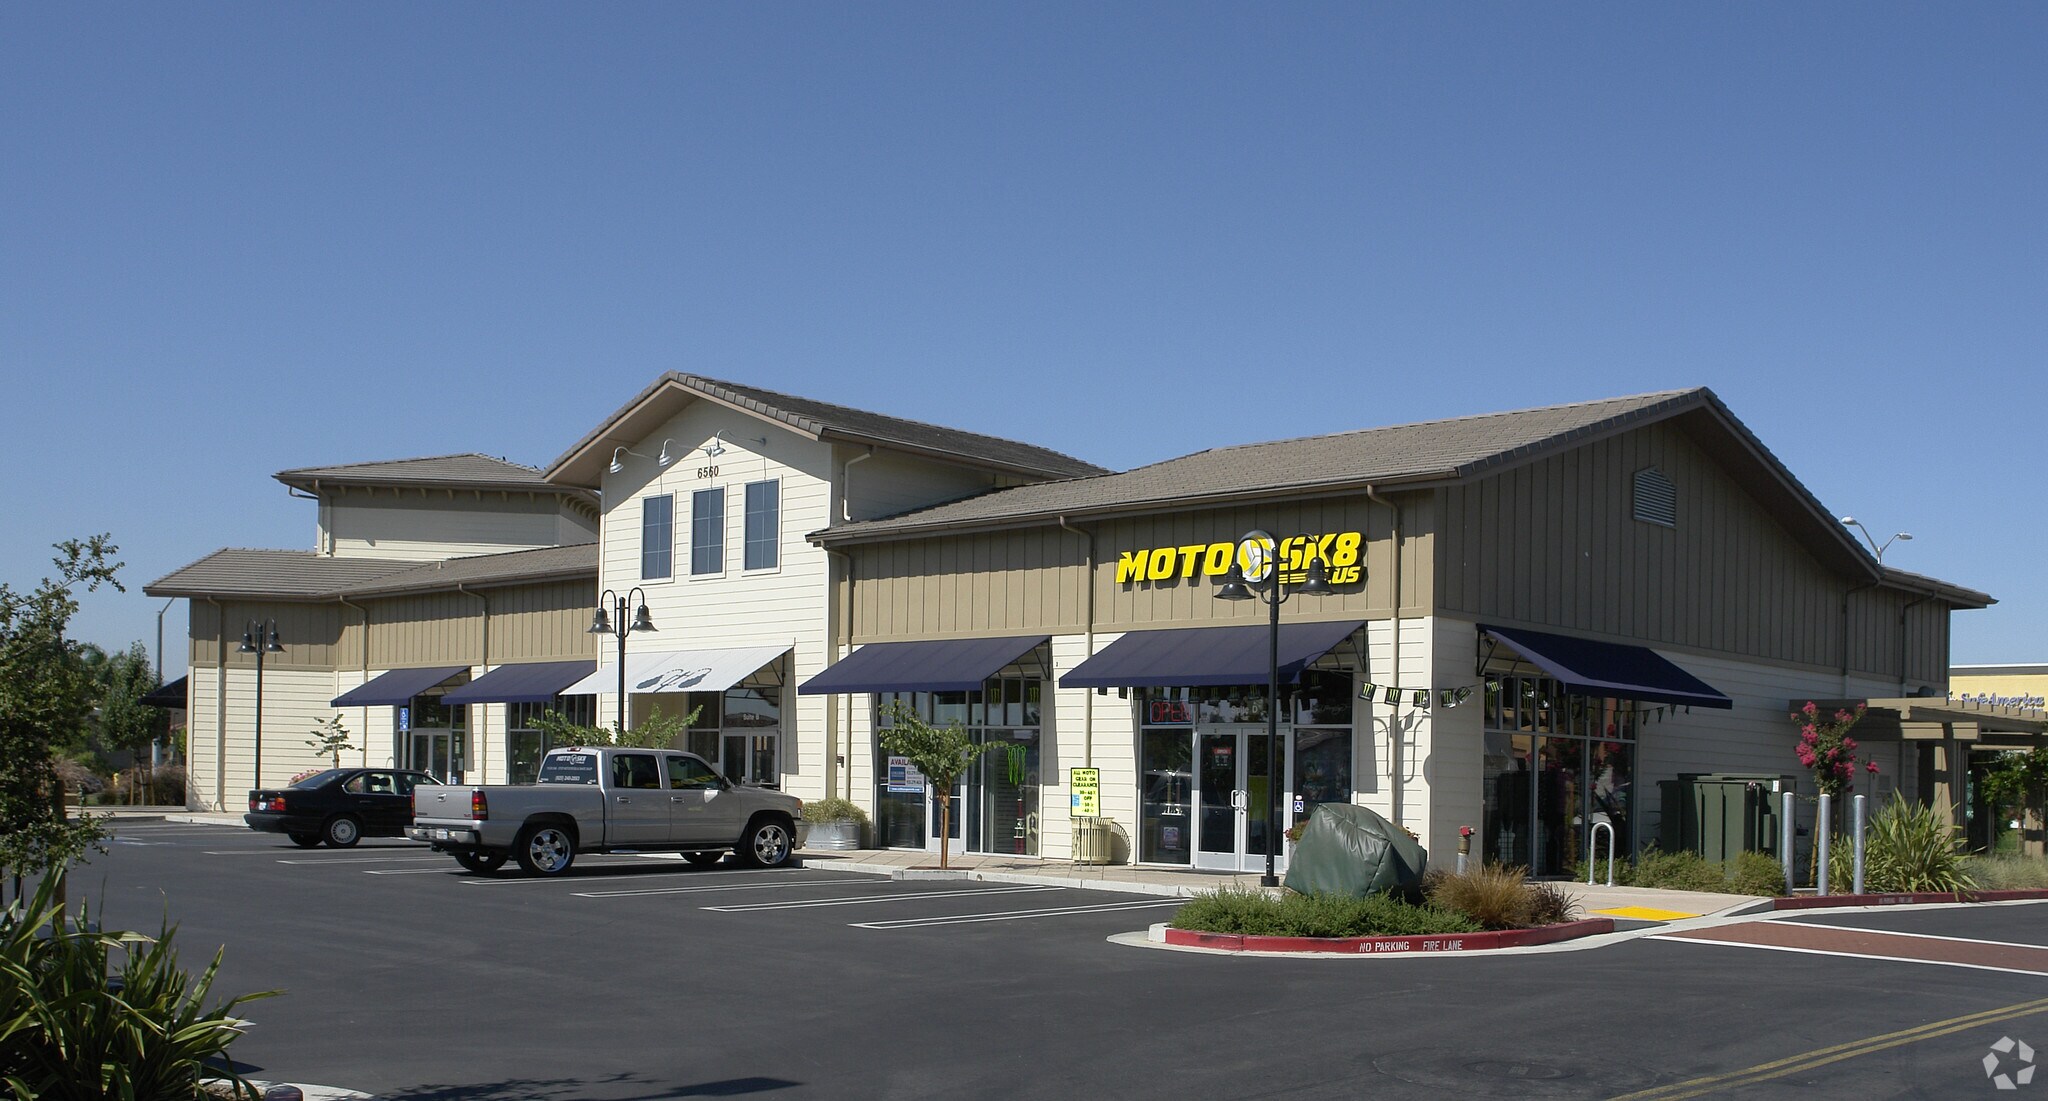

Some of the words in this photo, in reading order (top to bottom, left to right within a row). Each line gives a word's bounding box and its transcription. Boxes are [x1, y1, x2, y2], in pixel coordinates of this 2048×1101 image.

[697, 465, 719, 479] 6560
[1116, 542, 1235, 583] MOTO
[1279, 532, 1361, 571] SK8
[1151, 701, 1191, 722] OPEN
[1252, 705, 1258, 714] D
[1359, 942, 1372, 953] NO
[1374, 941, 1410, 952] PARKING
[1422, 940, 1440, 951] FIRE
[1442, 940, 1463, 951] LANE
